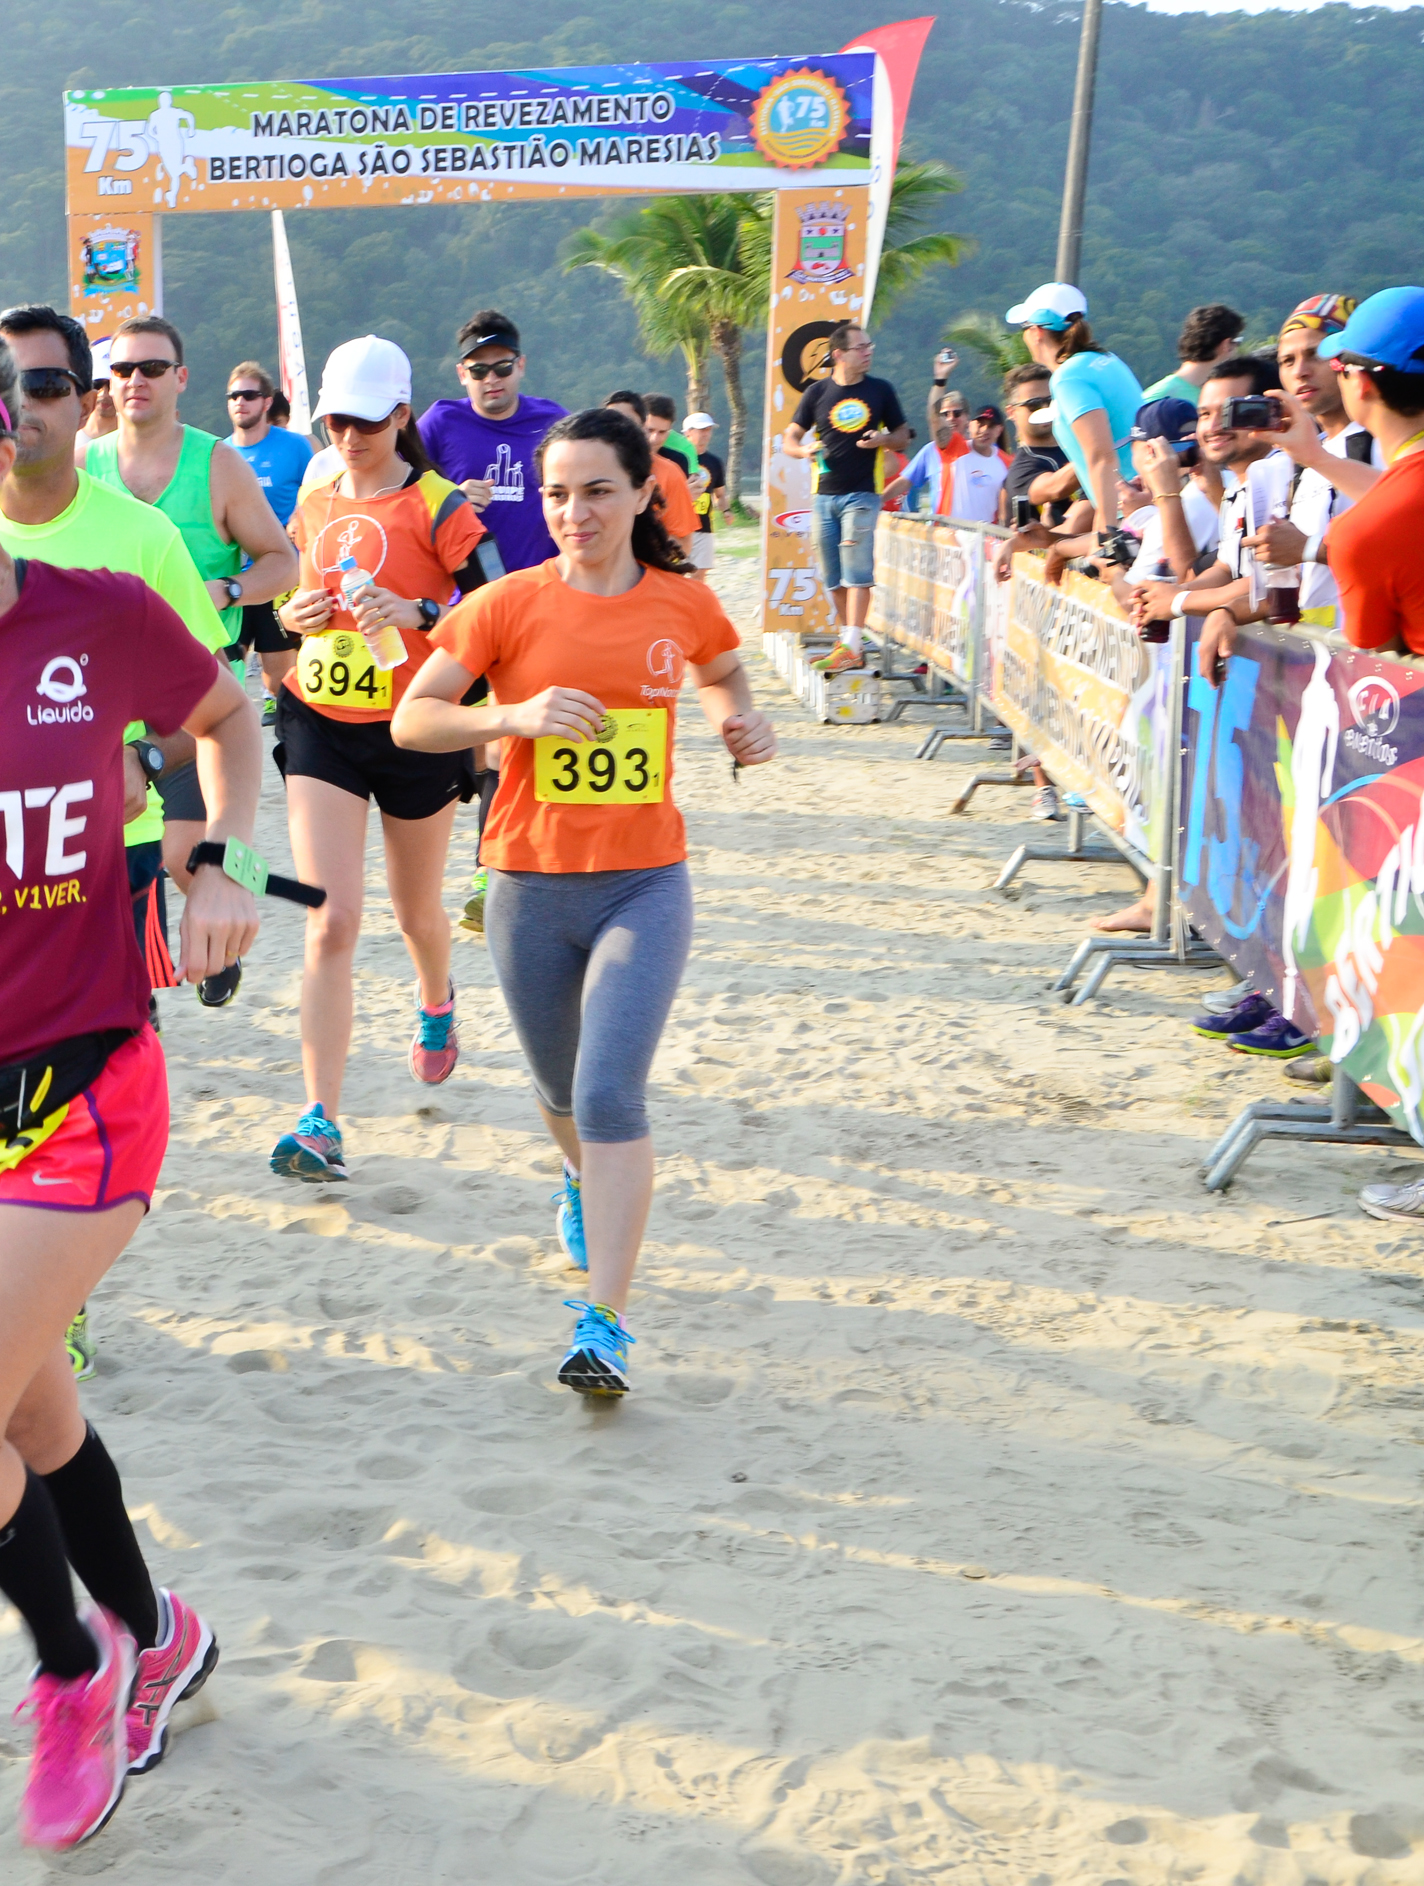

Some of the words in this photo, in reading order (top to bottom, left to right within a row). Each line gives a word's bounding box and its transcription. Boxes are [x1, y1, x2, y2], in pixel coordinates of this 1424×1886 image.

[253, 105, 413, 138] MARATONA
[420, 103, 456, 131] DE
[464, 93, 674, 129] REVEZAMENTO
[795, 95, 827, 118] 75
[79, 119, 149, 173] 75
[209, 151, 349, 181] BERTIOGA
[358, 142, 412, 176] SÃO
[421, 136, 571, 173] SEBASTIÃO
[579, 132, 721, 166] MARESIAS
[97, 176, 133, 195] Km
[768, 568, 817, 601] 75
[305, 658, 379, 699] 394
[552, 748, 649, 793] 393
[653, 772, 660, 787] 1
